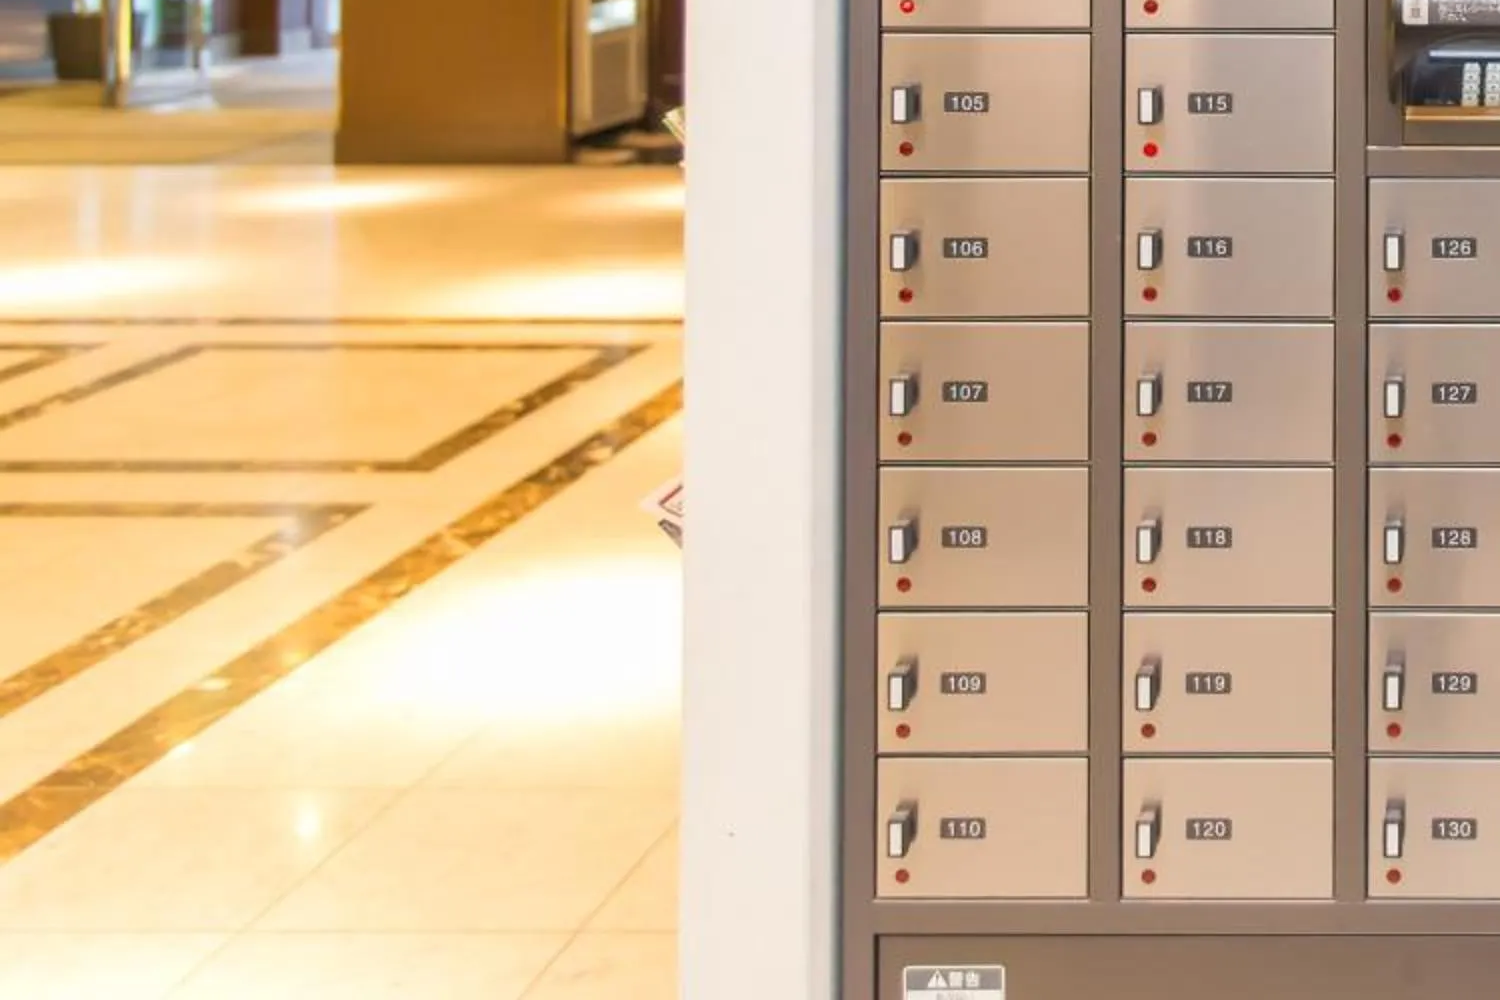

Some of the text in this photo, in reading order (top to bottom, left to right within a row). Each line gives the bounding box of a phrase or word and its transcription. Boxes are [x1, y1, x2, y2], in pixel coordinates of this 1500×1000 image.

[951, 95, 984, 111] 105
[1195, 95, 1228, 112] 115
[950, 240, 983, 257] 106
[1194, 239, 1227, 255] 116
[1439, 239, 1471, 256] 126
[949, 384, 983, 401] 107
[1194, 384, 1227, 400] 117
[1439, 385, 1471, 401] 127
[949, 529, 982, 546] 108
[1194, 529, 1227, 546] 118
[1439, 529, 1471, 546] 128
[949, 675, 981, 692] 109
[1194, 675, 1225, 691] 119
[1439, 675, 1471, 692] 129
[947, 820, 981, 837] 110
[1193, 821, 1227, 837] 120
[1438, 821, 1472, 837] 130
